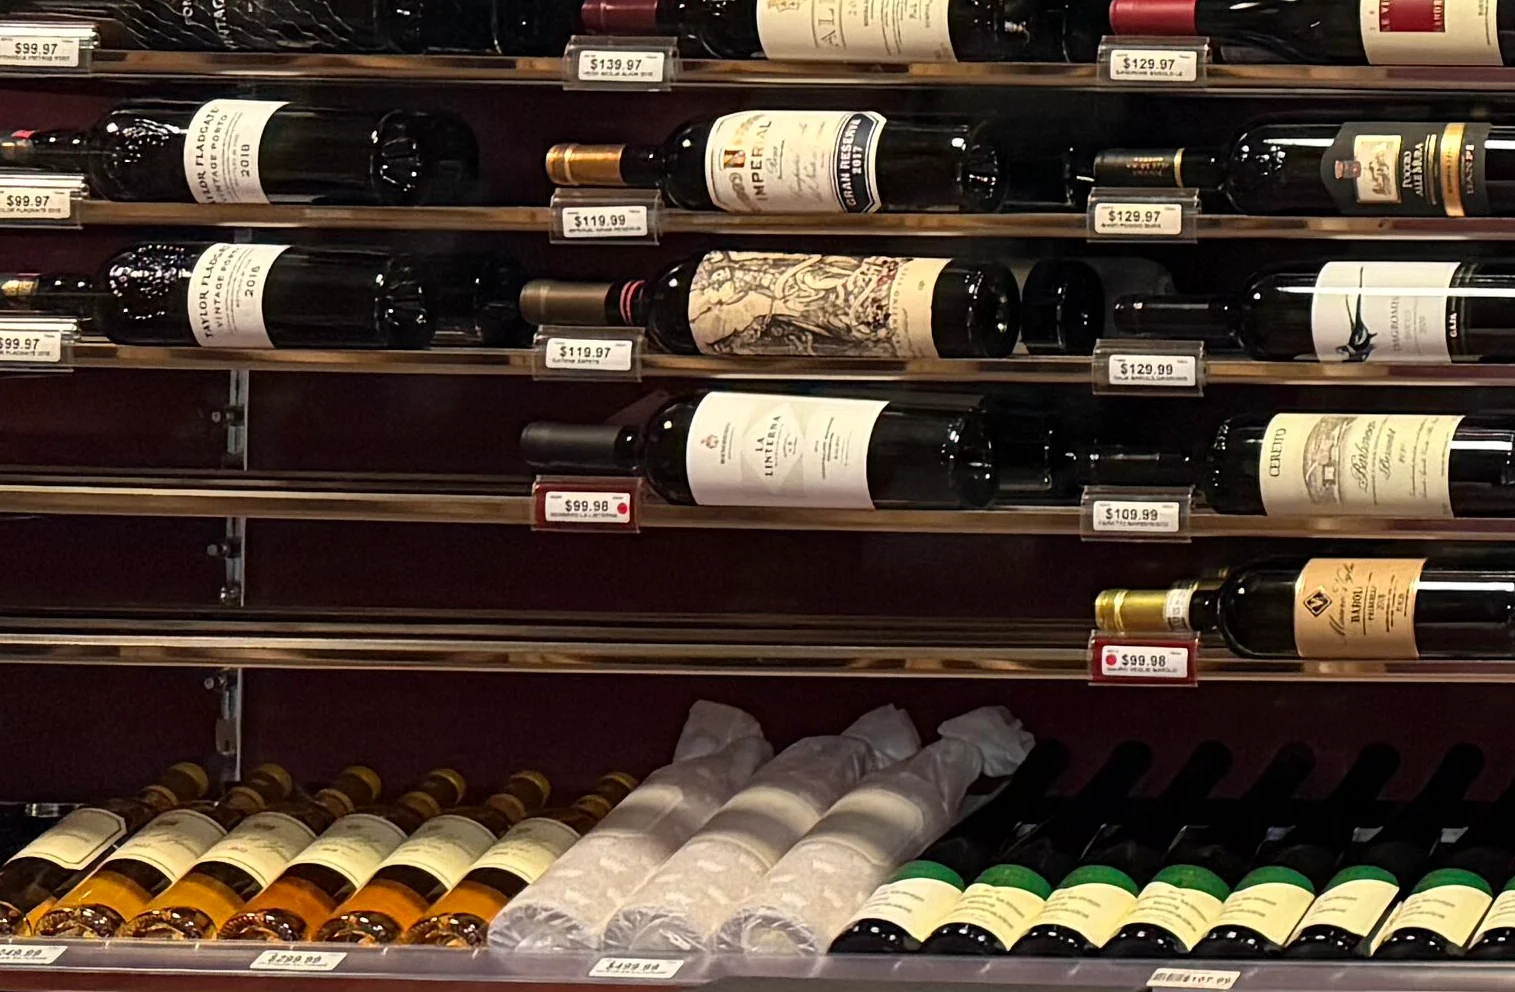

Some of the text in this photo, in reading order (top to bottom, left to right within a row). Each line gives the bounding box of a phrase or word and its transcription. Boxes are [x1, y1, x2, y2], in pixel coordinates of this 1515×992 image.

[14, 42, 58, 55] $99.97
[590, 58, 642, 71] $139.97
[1123, 57, 1175, 70] $129.97
[240, 144, 250, 177] 2018
[750, 121, 772, 201] IMPERIAL
[840, 119, 861, 206] GRAN RESERVA
[852, 146, 864, 174] 2017
[6, 194, 50, 207] $99.97
[574, 214, 626, 228] $119.99
[1108, 210, 1161, 223] $129.97
[215, 275, 224, 328] VINTAGE
[199, 289, 214, 338] TAYLOR
[559, 345, 611, 358] $119.97
[1120, 363, 1173, 375] $129.99
[755, 437, 765, 453] LA
[763, 416, 781, 477] LINTERNA
[1269, 428, 1286, 477] CERETTO
[564, 499, 609, 513] $99.98
[1105, 507, 1158, 521] $109.99
[1121, 654, 1166, 667] $99.98
